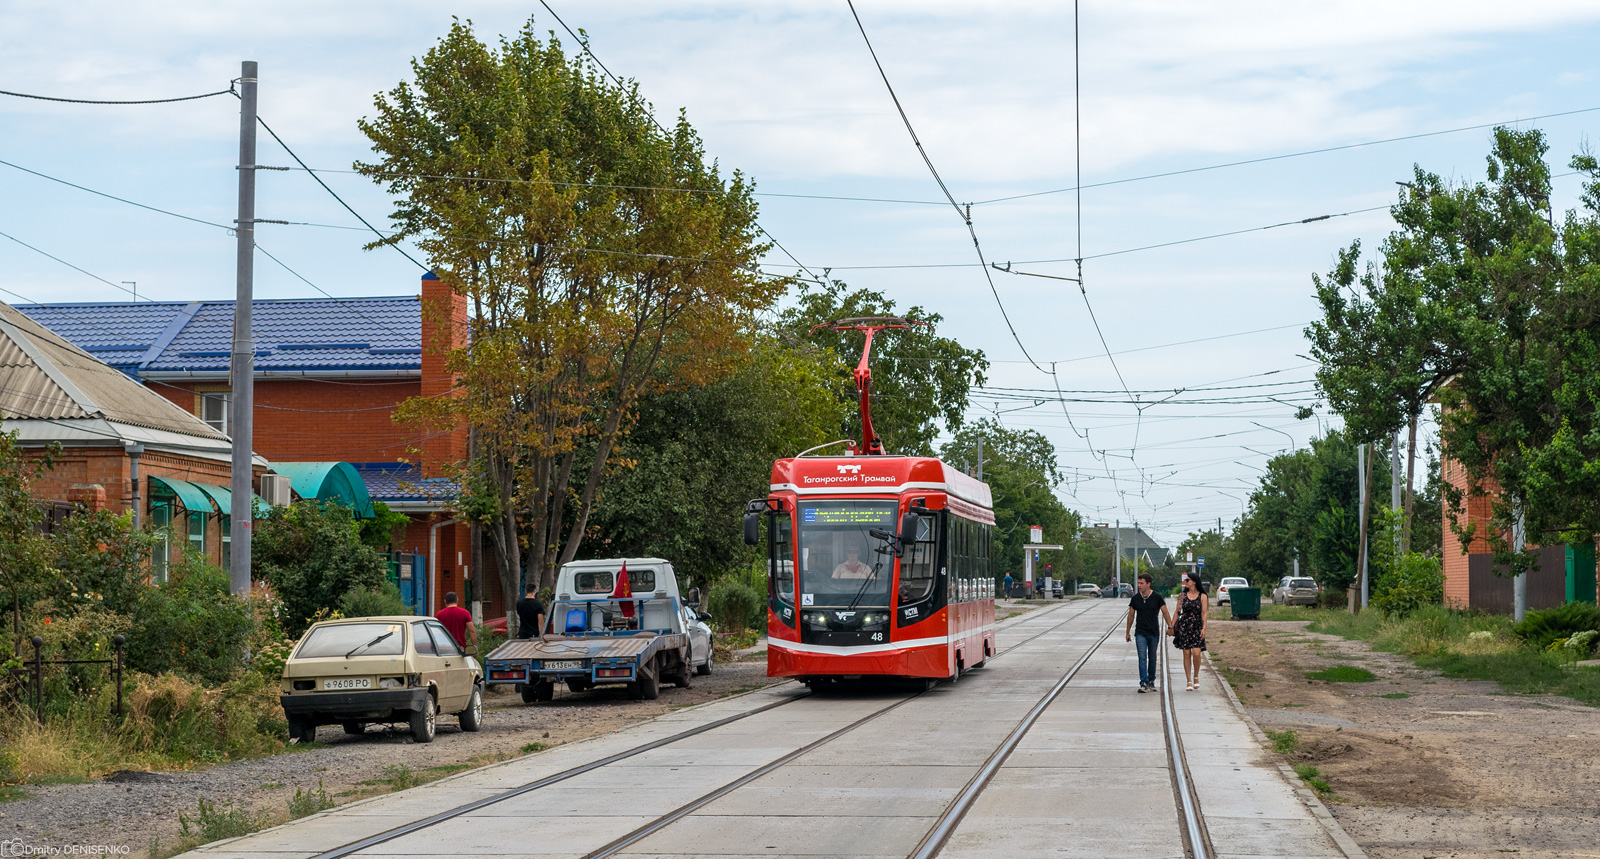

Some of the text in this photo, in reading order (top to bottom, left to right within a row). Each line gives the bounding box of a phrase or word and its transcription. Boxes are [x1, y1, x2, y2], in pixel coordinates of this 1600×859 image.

[803, 474, 896, 484] Таганрогский Трамвай
[871, 632, 883, 642] 48
